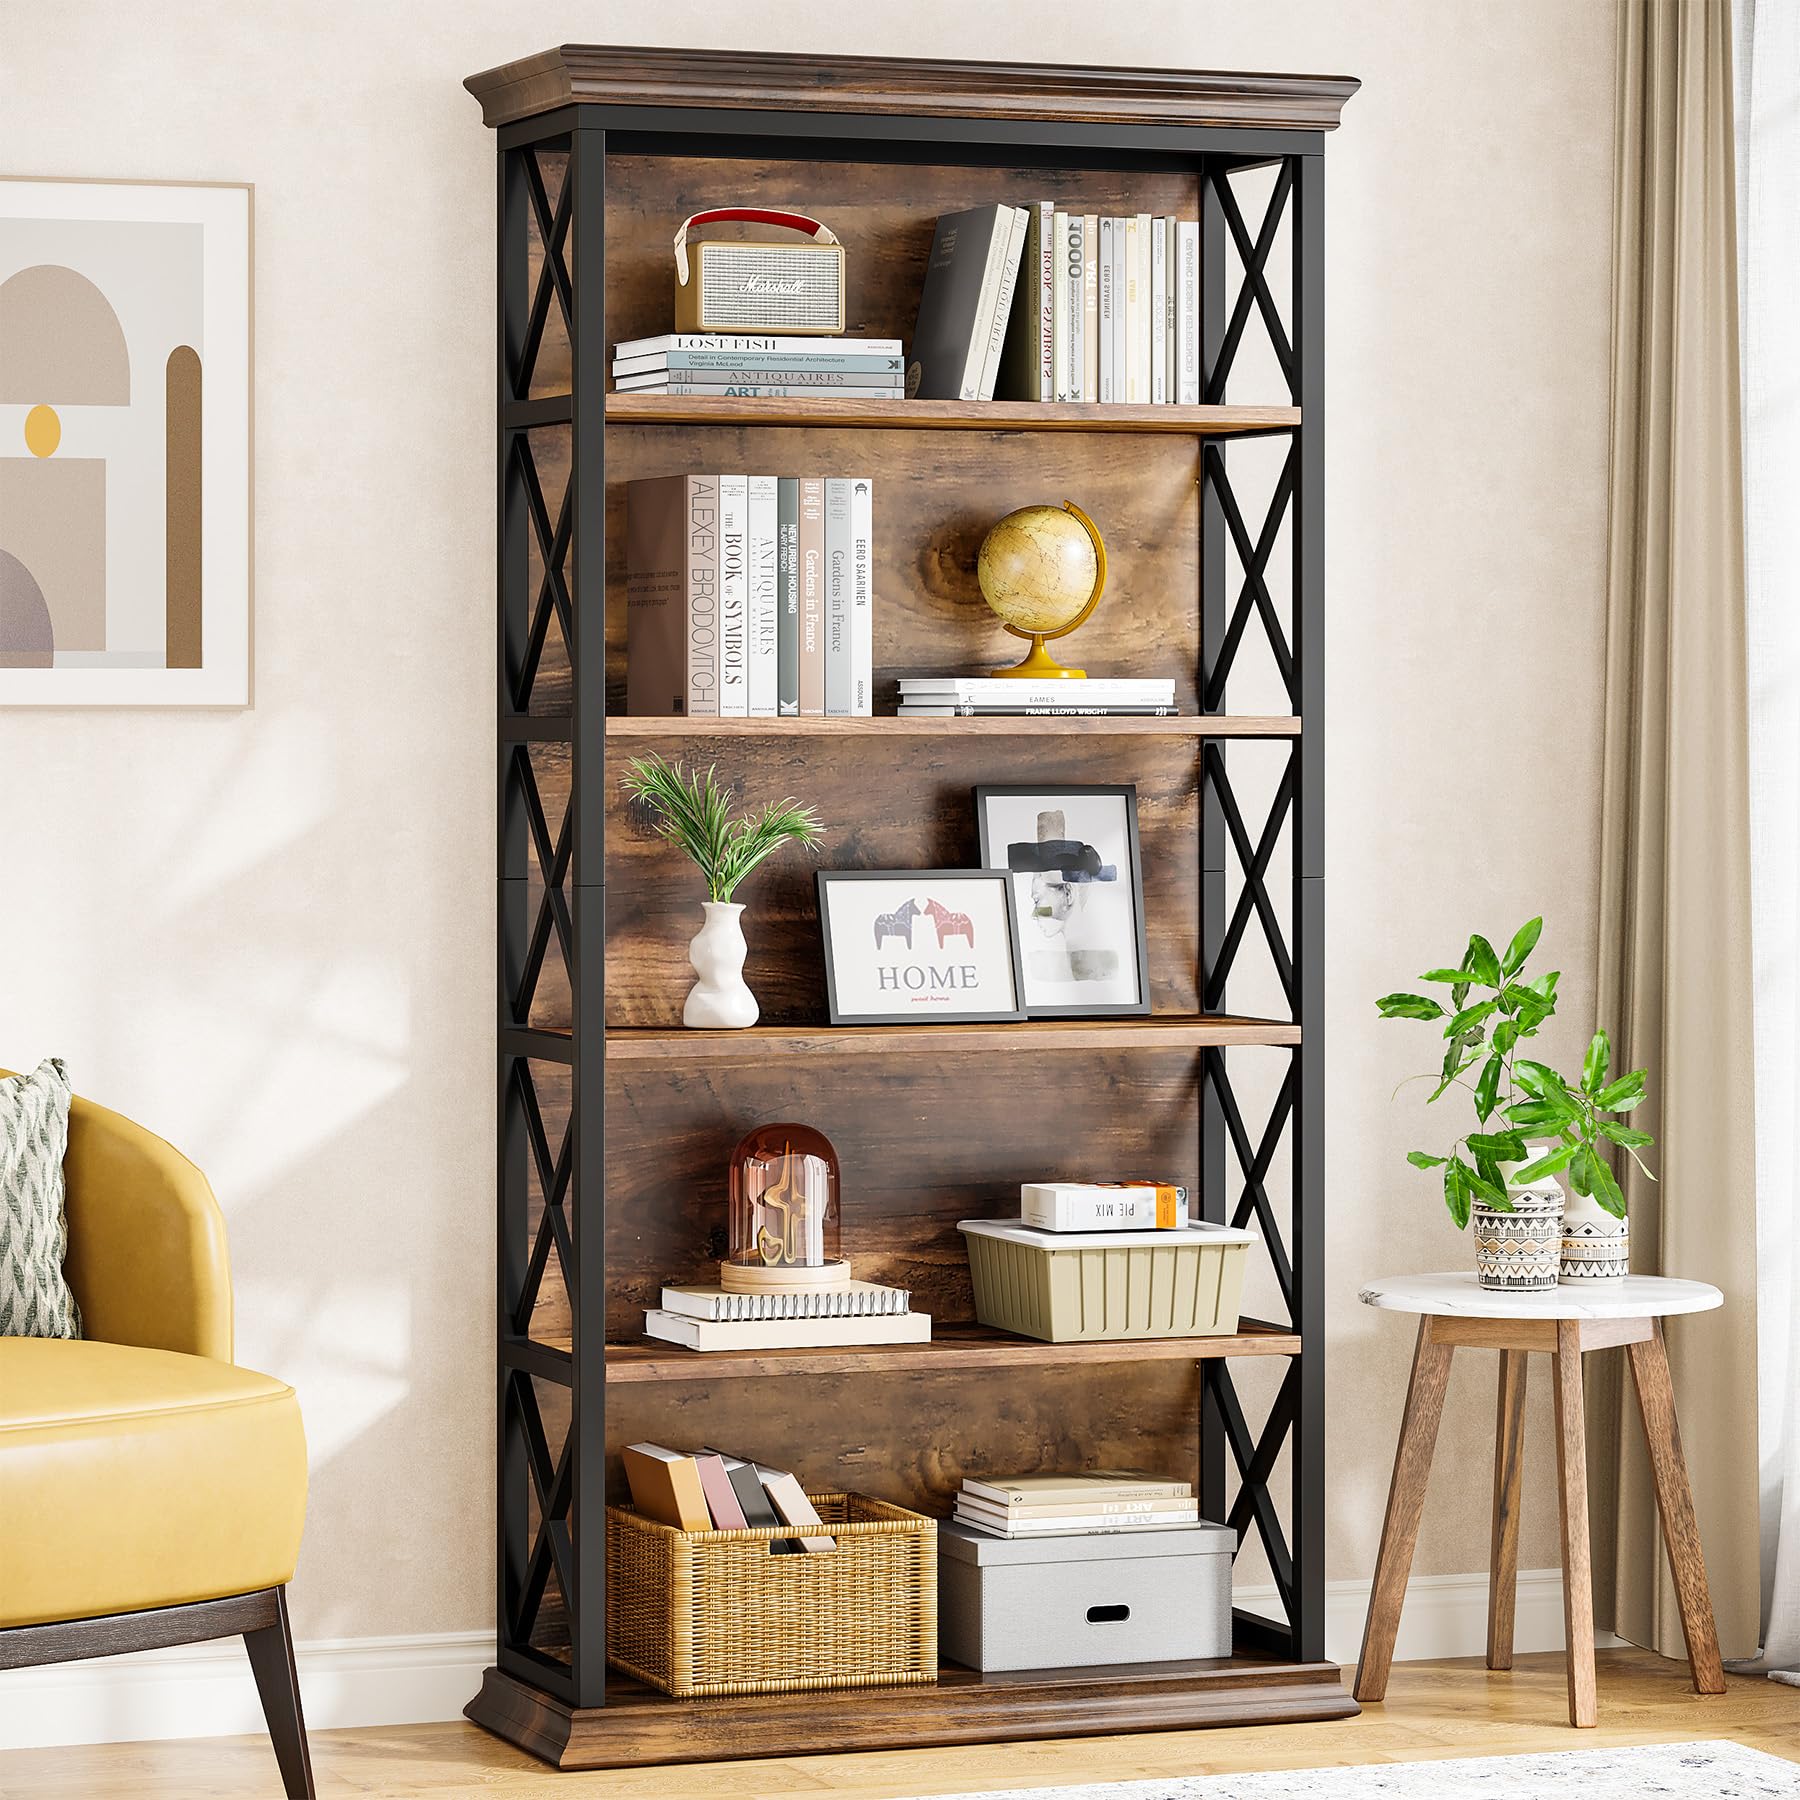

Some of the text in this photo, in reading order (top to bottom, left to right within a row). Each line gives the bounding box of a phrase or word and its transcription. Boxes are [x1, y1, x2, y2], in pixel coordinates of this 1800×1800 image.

[678, 338, 776, 350] LOST FISH
[724, 386, 761, 397] ART
[729, 372, 845, 382] ANTIQUAIRES
[780, 523, 788, 572] HILARY FRENCH
[788, 523, 797, 614] NEW URBAN HOUSING
[856, 538, 866, 606] EERO SAARINEN
[691, 480, 715, 703] ALEXEY BRODOVITCH
[725, 513, 743, 685] THE BOOK OF SYMBOLS
[757, 538, 775, 656] ANTIQUAIRES
[805, 549, 819, 653] Gardens in France
[832, 550, 845, 653] Gardens in France
[877, 965, 980, 990] HOME
[1095, 1203, 1135, 1217] PIE MIX
[1125, 1502, 1153, 1512] ART
